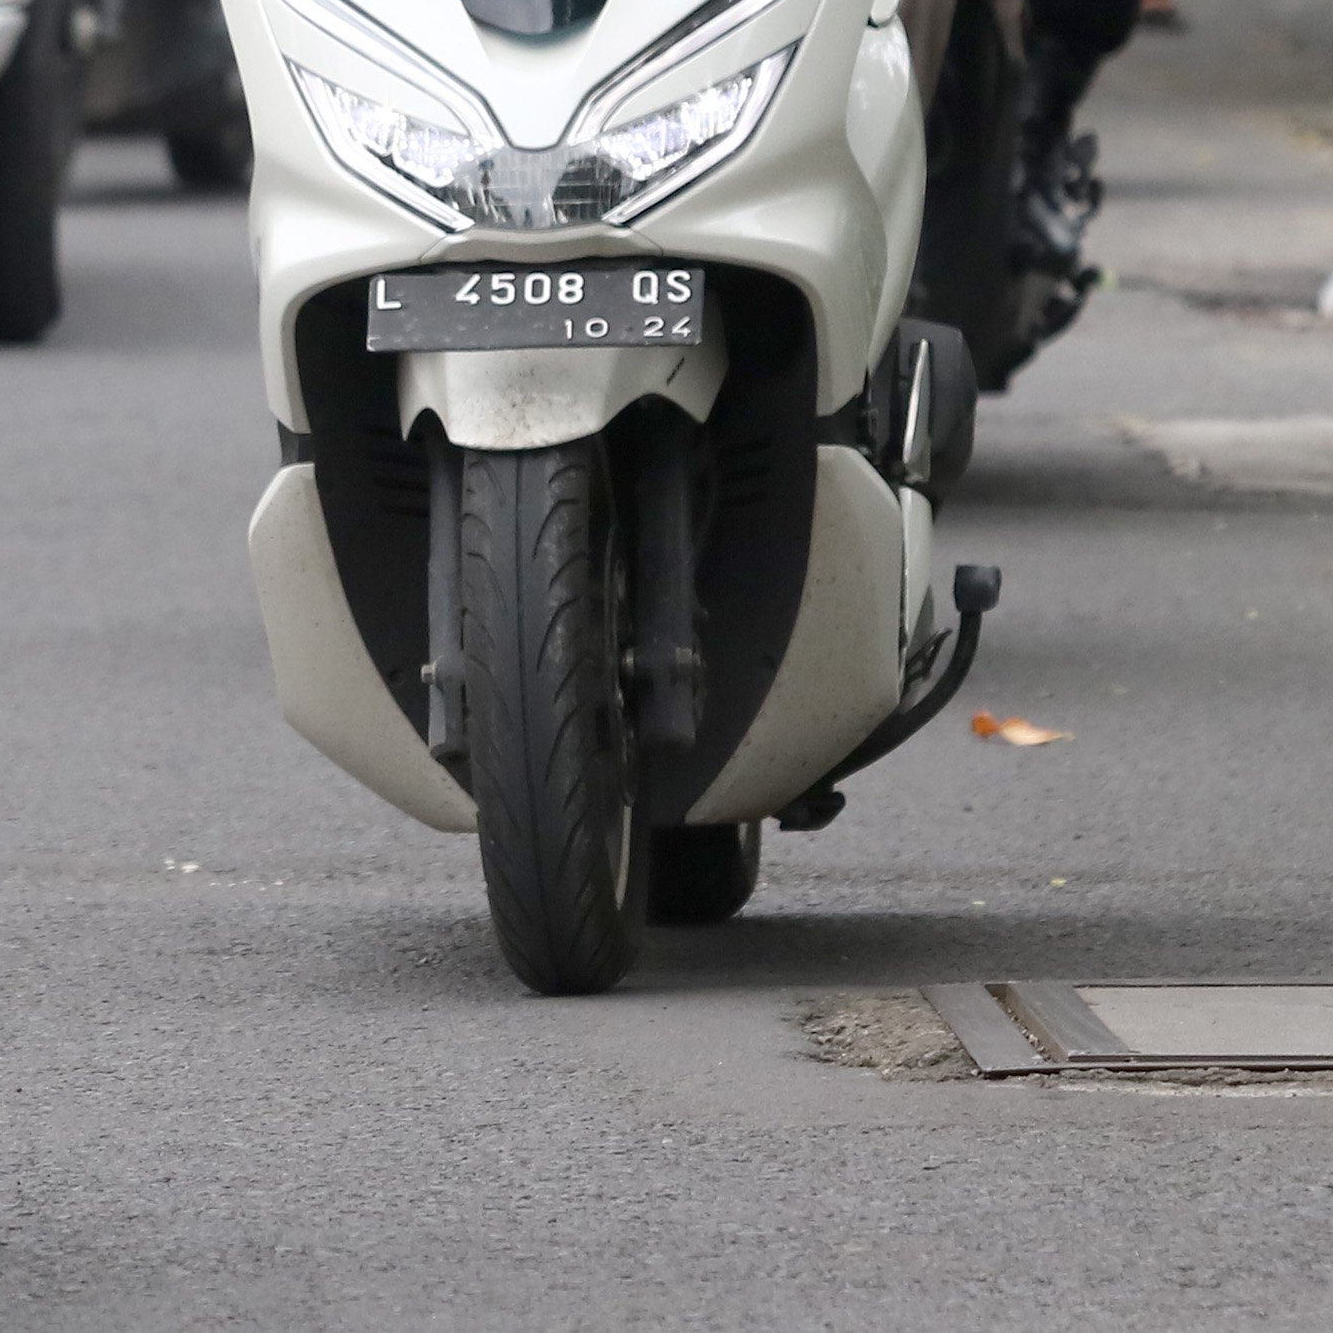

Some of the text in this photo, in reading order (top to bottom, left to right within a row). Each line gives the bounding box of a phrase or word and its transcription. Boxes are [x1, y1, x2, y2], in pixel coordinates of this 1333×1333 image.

[375, 269, 692, 310] L 4508 QS
[564, 316, 692, 341] 10 24
